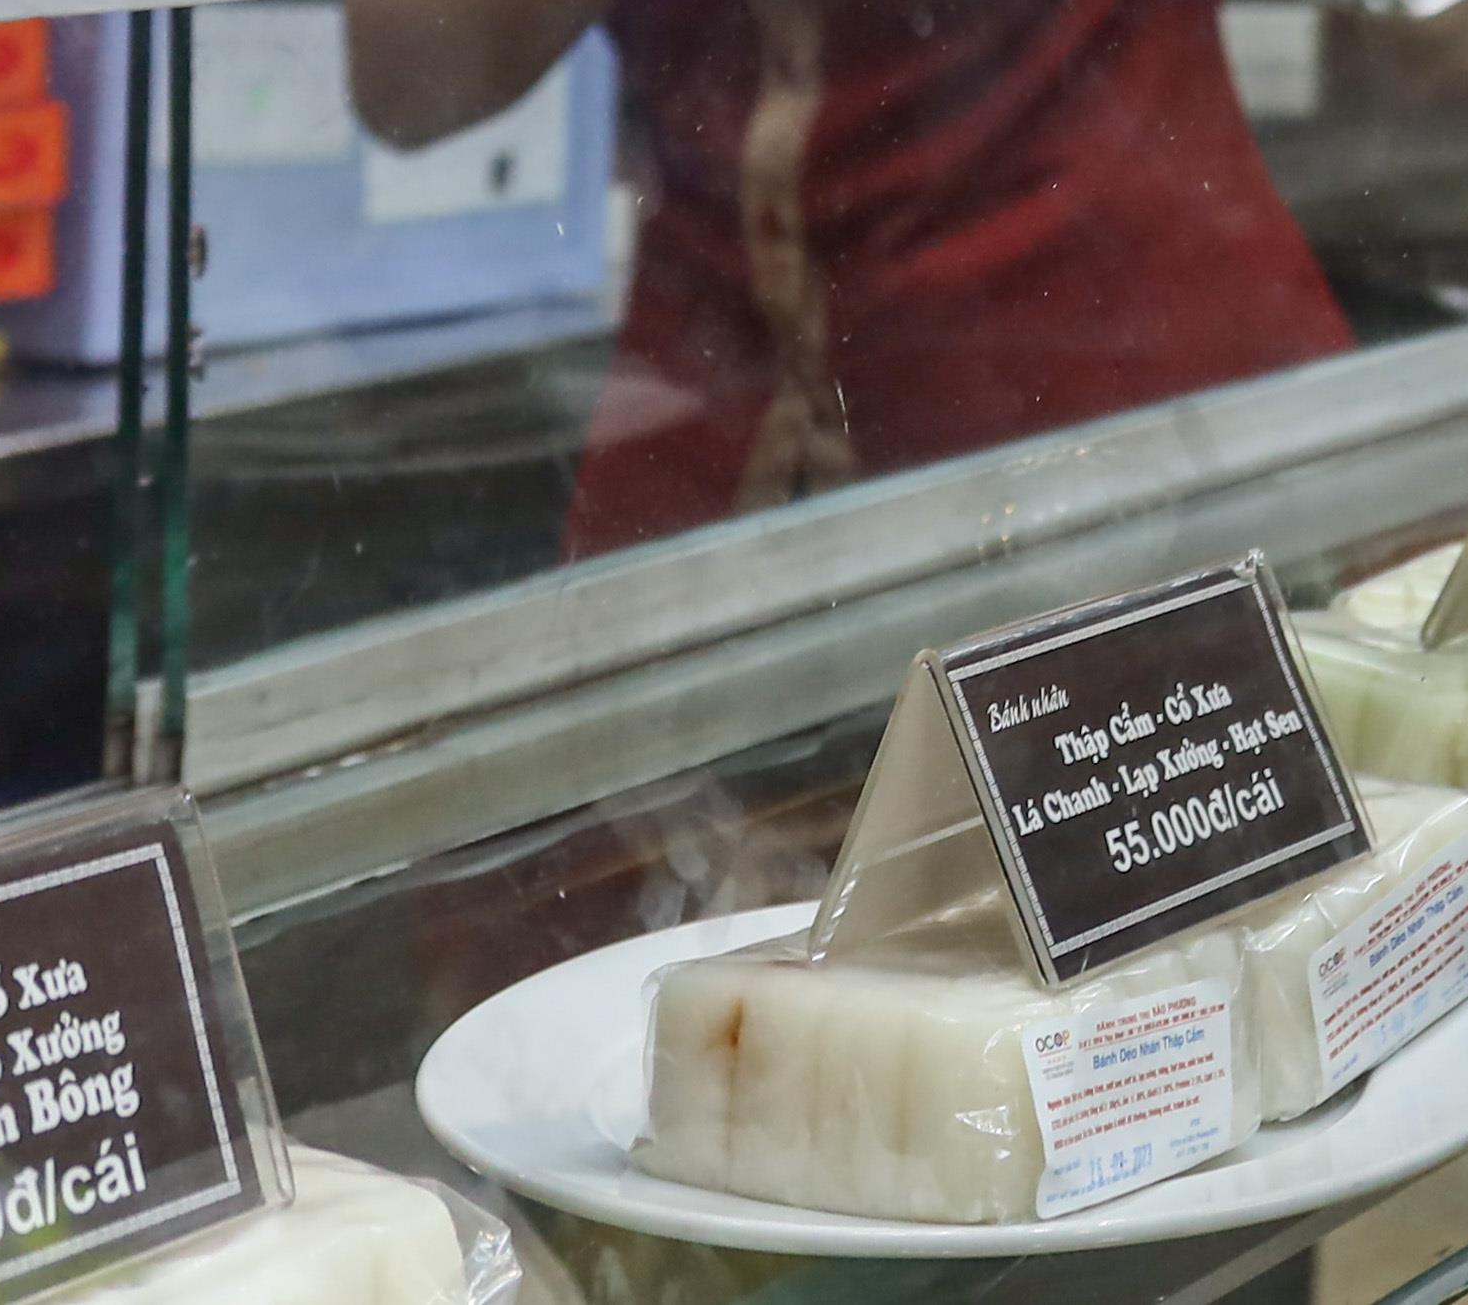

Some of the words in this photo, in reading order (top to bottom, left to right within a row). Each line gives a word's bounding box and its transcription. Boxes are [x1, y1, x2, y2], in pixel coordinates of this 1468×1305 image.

[987, 694, 1031, 733] Bánh
[1031, 684, 1070, 719] nhân
[1054, 725, 1111, 765] Thập
[1109, 701, 1157, 745] Cẩm
[1163, 682, 1193, 725] Cổ
[1190, 682, 1232, 717] Xưa
[1011, 798, 1044, 837] Lá
[1042, 776, 1112, 823] Chanh
[1117, 763, 1160, 798] Lạp
[1227, 718, 1268, 755] Hạt
[1264, 709, 1303, 739] Sen
[1105, 767, 1285, 873] 55.000đ/cái
[12, 957, 88, 1010] Xưa
[6, 1010, 127, 1076] Xưởng
[1035, 1029, 1070, 1053] OCOP
[24, 1062, 141, 1135] Bông
